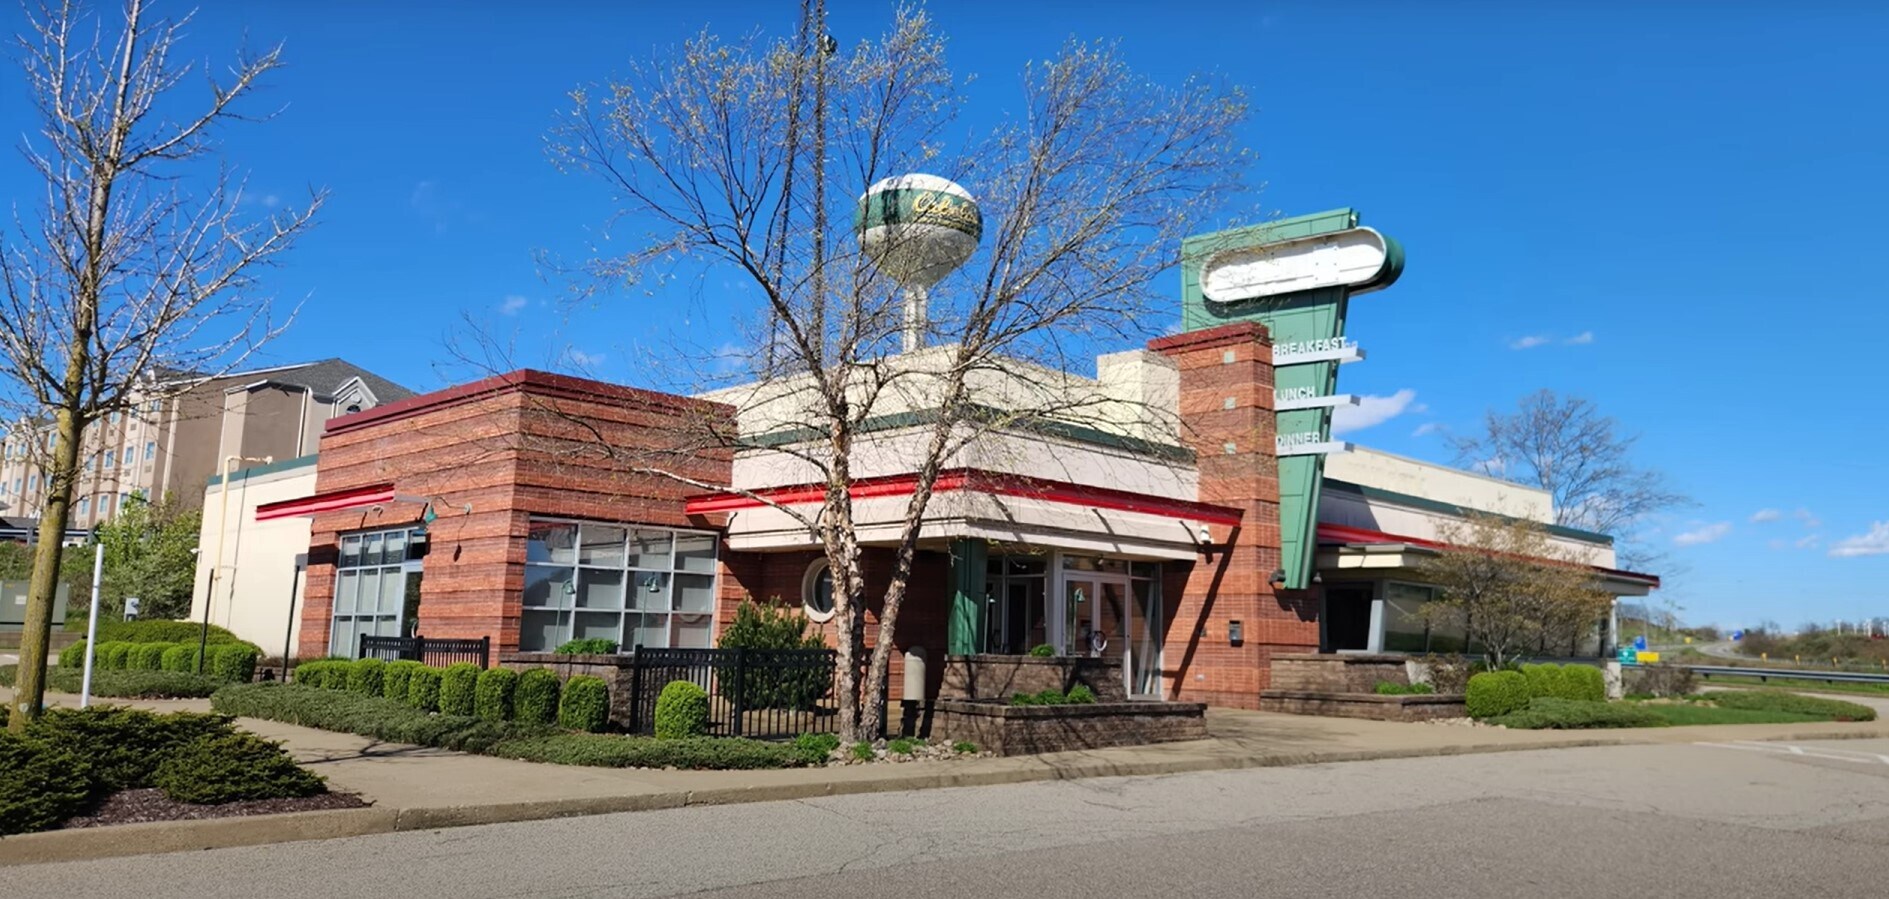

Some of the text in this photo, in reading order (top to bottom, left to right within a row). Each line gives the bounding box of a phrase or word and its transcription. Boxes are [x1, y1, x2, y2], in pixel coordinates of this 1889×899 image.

[1272, 336, 1346, 356] BREAKFAST
[1273, 386, 1315, 401] LUNCH
[1276, 432, 1320, 447] DINNER
